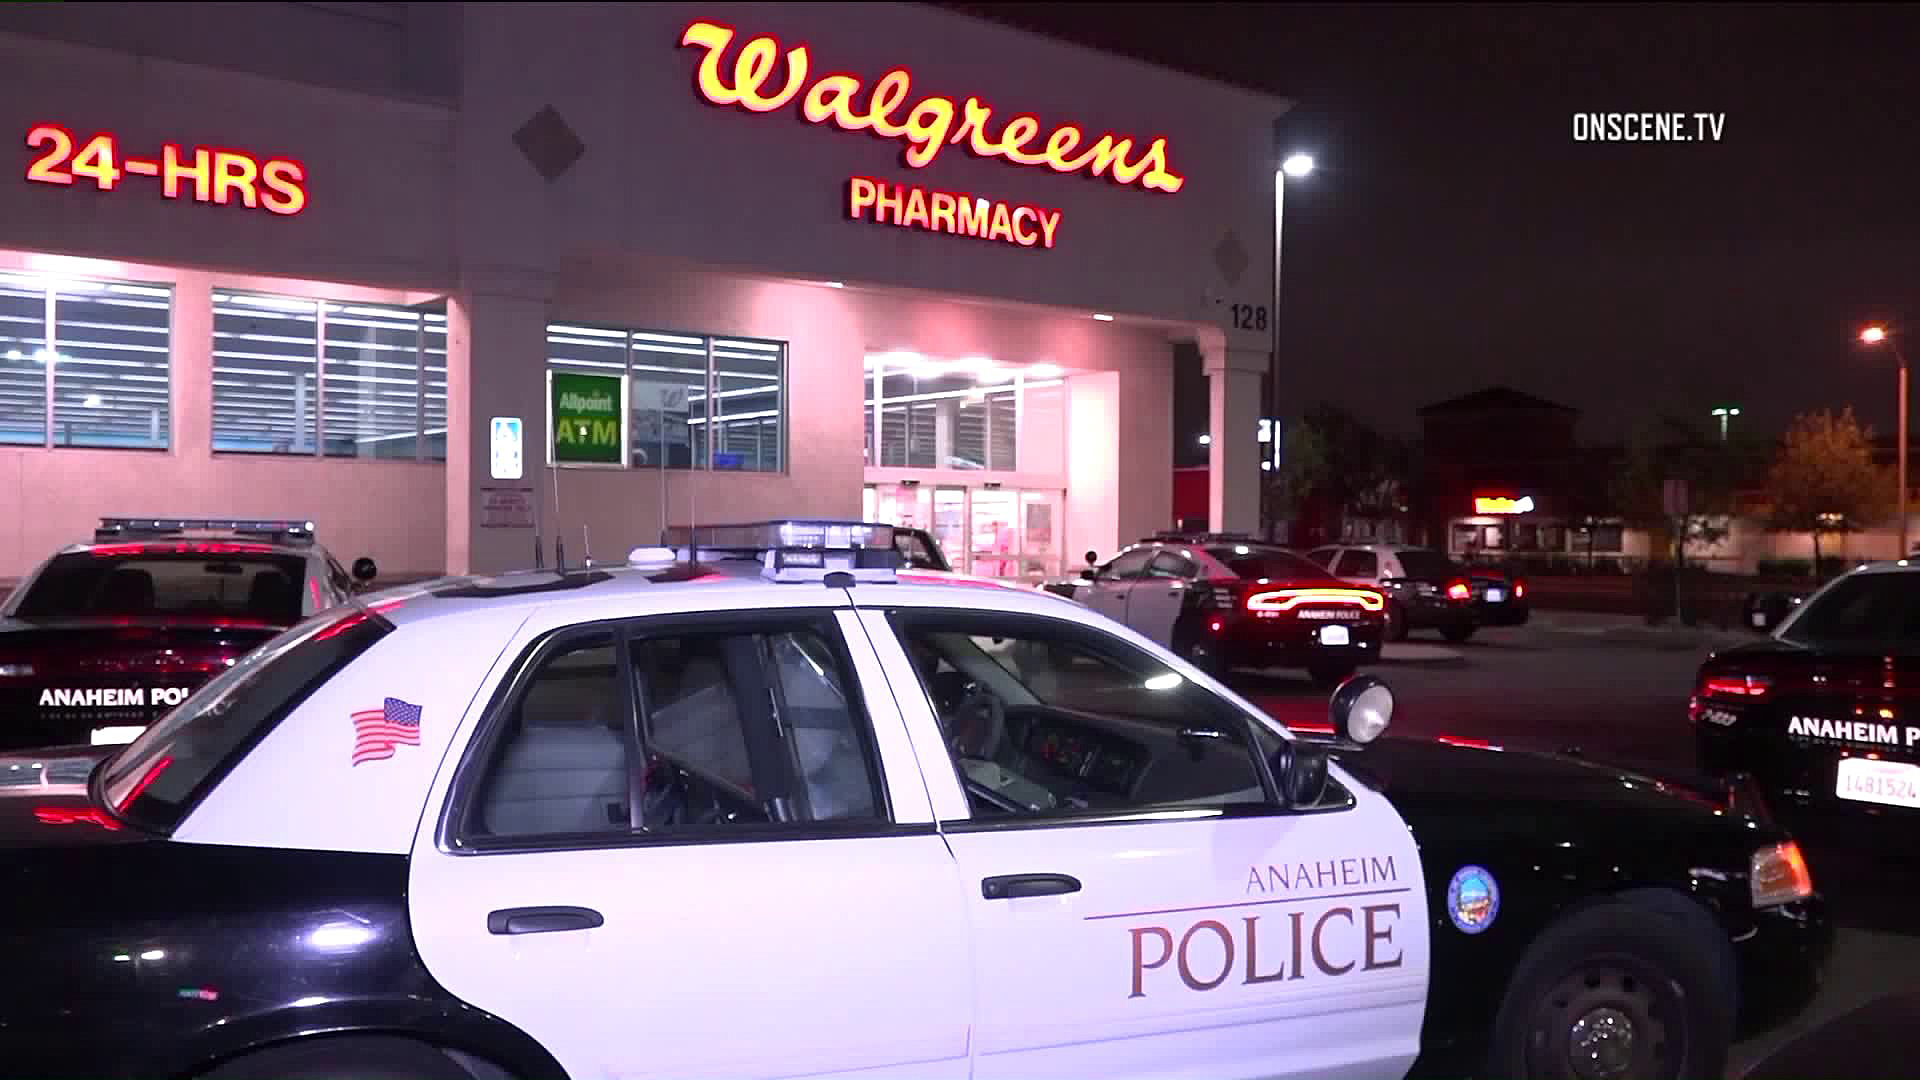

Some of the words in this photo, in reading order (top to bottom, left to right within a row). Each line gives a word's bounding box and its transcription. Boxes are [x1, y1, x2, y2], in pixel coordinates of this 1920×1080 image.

[682, 21, 1184, 193] Walgreens
[26, 125, 305, 214] 24-HRS
[849, 177, 1062, 249] PHARMACY
[1231, 304, 1267, 330] 128
[559, 389, 613, 413] Allpoint
[557, 418, 617, 446] ATM
[39, 688, 144, 706] ANAHEIM
[1788, 716, 1898, 744] ANAHEIM
[1246, 855, 1397, 893] ANAHEIM
[1127, 903, 1403, 999] POLICE
